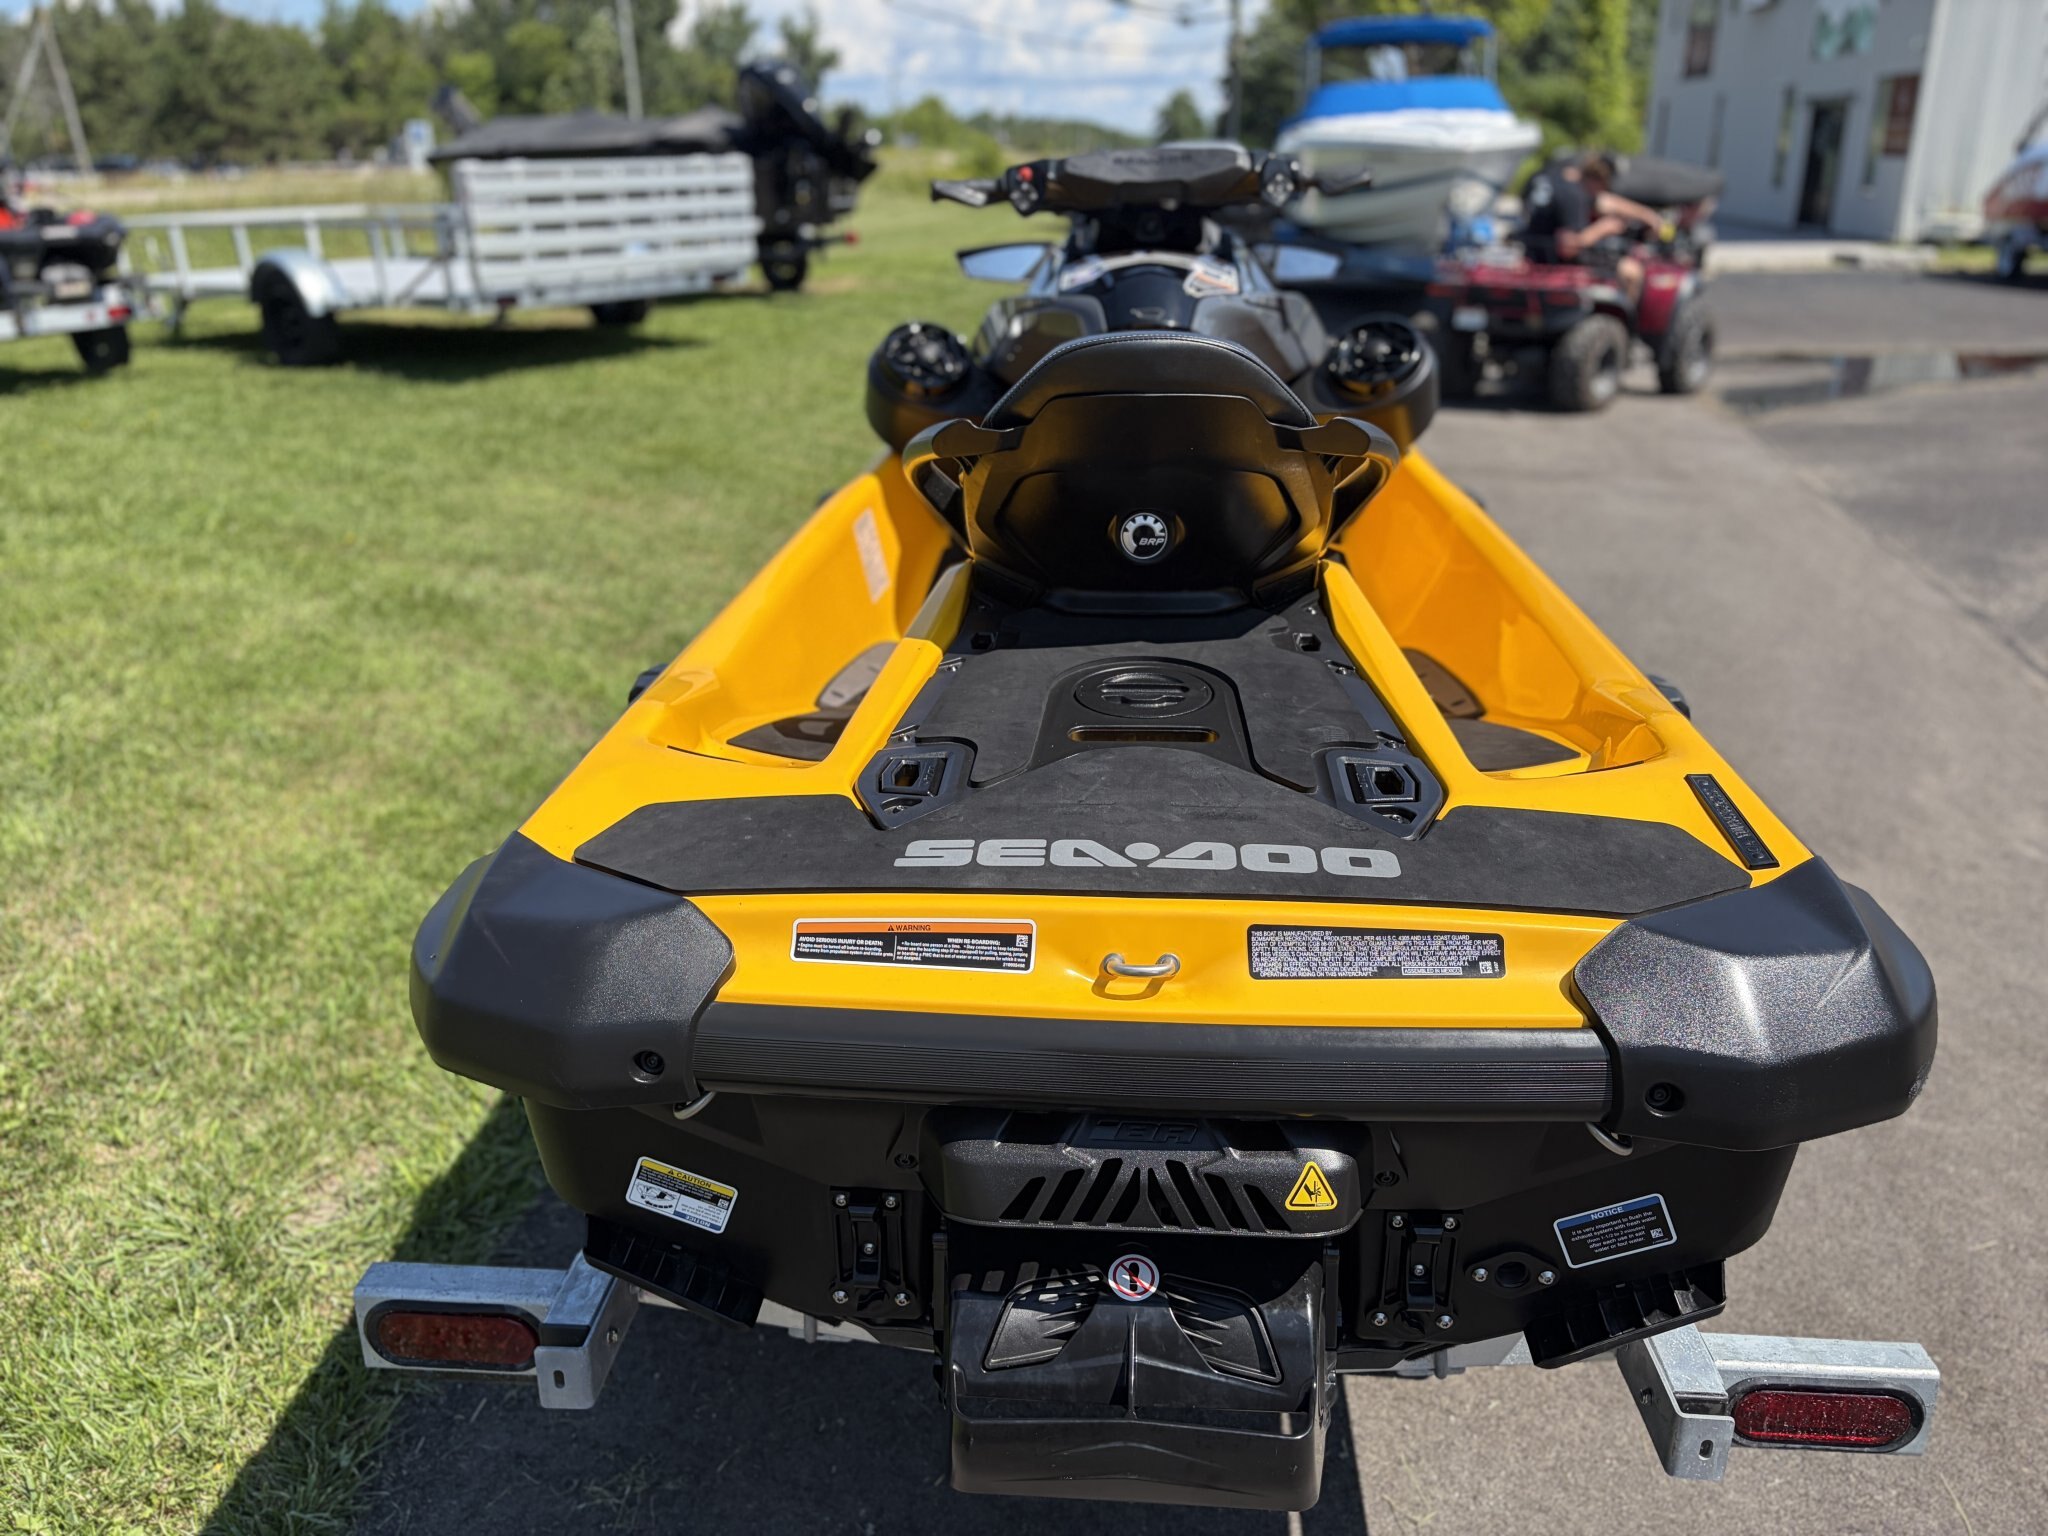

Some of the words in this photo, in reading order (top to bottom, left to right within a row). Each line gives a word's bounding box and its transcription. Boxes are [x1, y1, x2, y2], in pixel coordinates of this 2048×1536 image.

[1139, 538, 1164, 546] BRP
[677, 1172, 712, 1188] CAUTION
[1590, 1206, 1624, 1220] NOTICE
